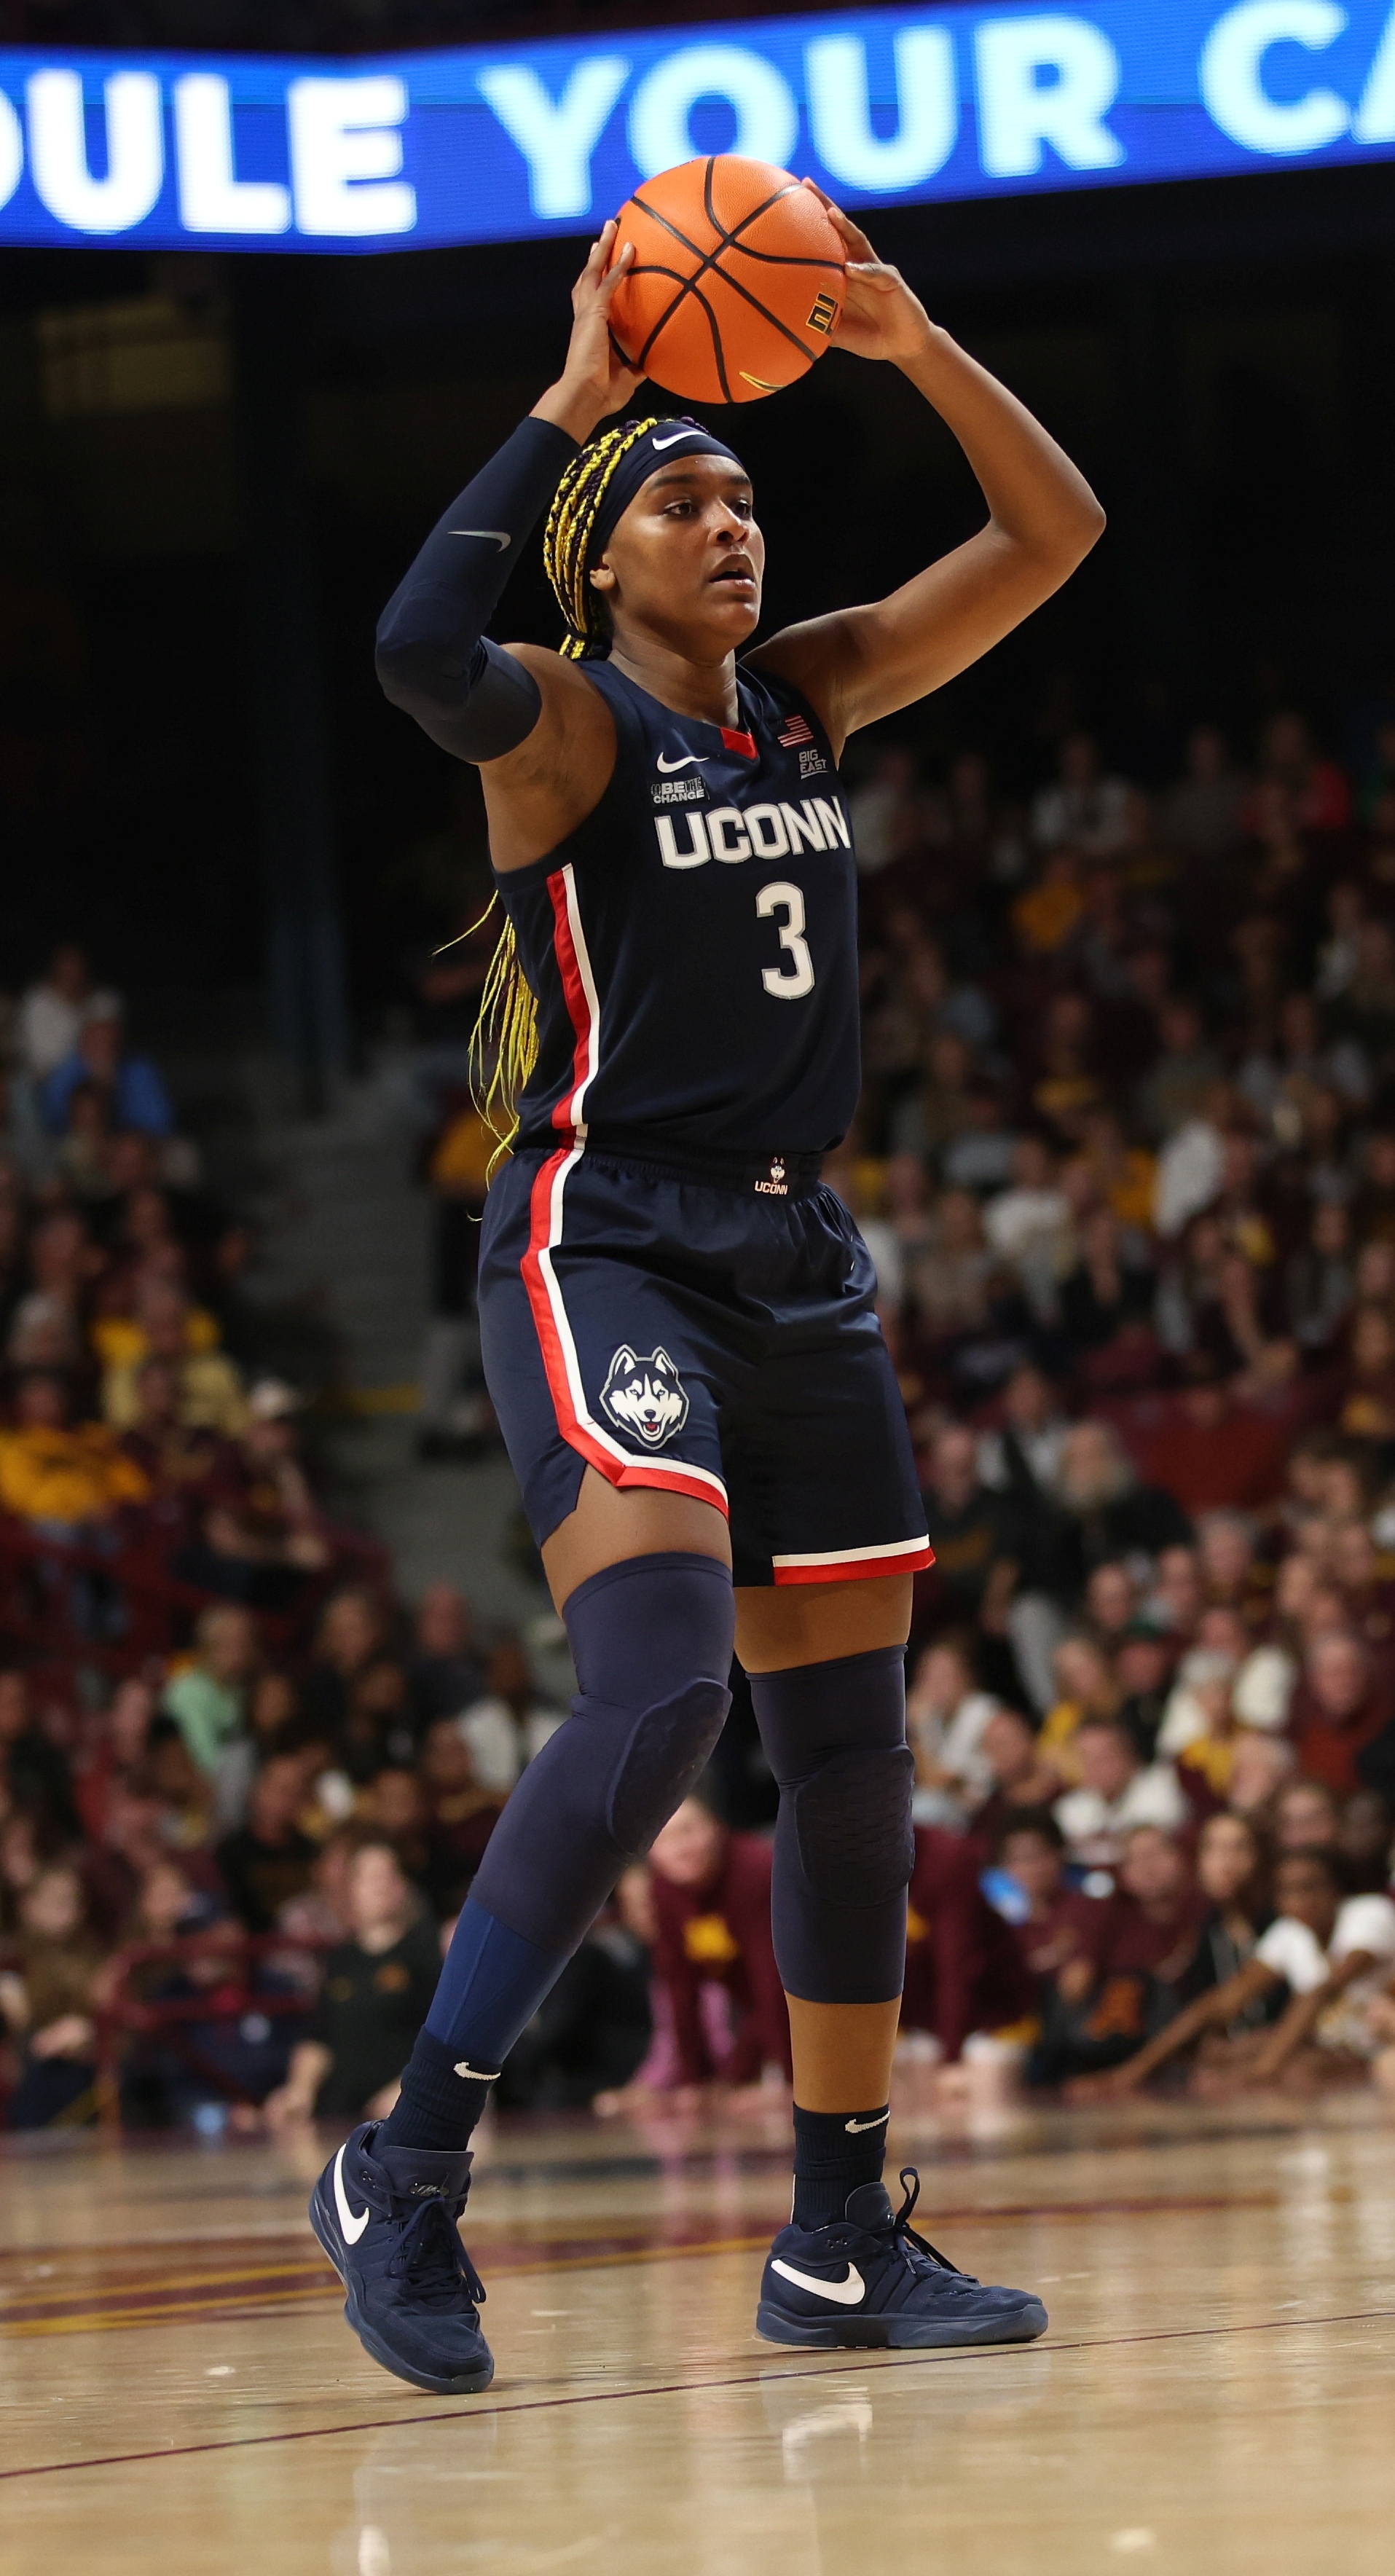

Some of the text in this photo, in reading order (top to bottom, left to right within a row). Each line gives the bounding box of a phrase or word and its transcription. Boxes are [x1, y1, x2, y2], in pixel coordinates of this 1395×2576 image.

[0, 68, 417, 236] ULE
[473, 13, 1128, 220] YOUR
[799, 749, 819, 763] BIG
[800, 758, 827, 773] EAST
[661, 782, 685, 795] BE
[653, 789, 705, 804] CHANGE
[655, 796, 852, 870] UCONN
[755, 881, 815, 1000] 3
[755, 1181, 788, 1195] UCONN
